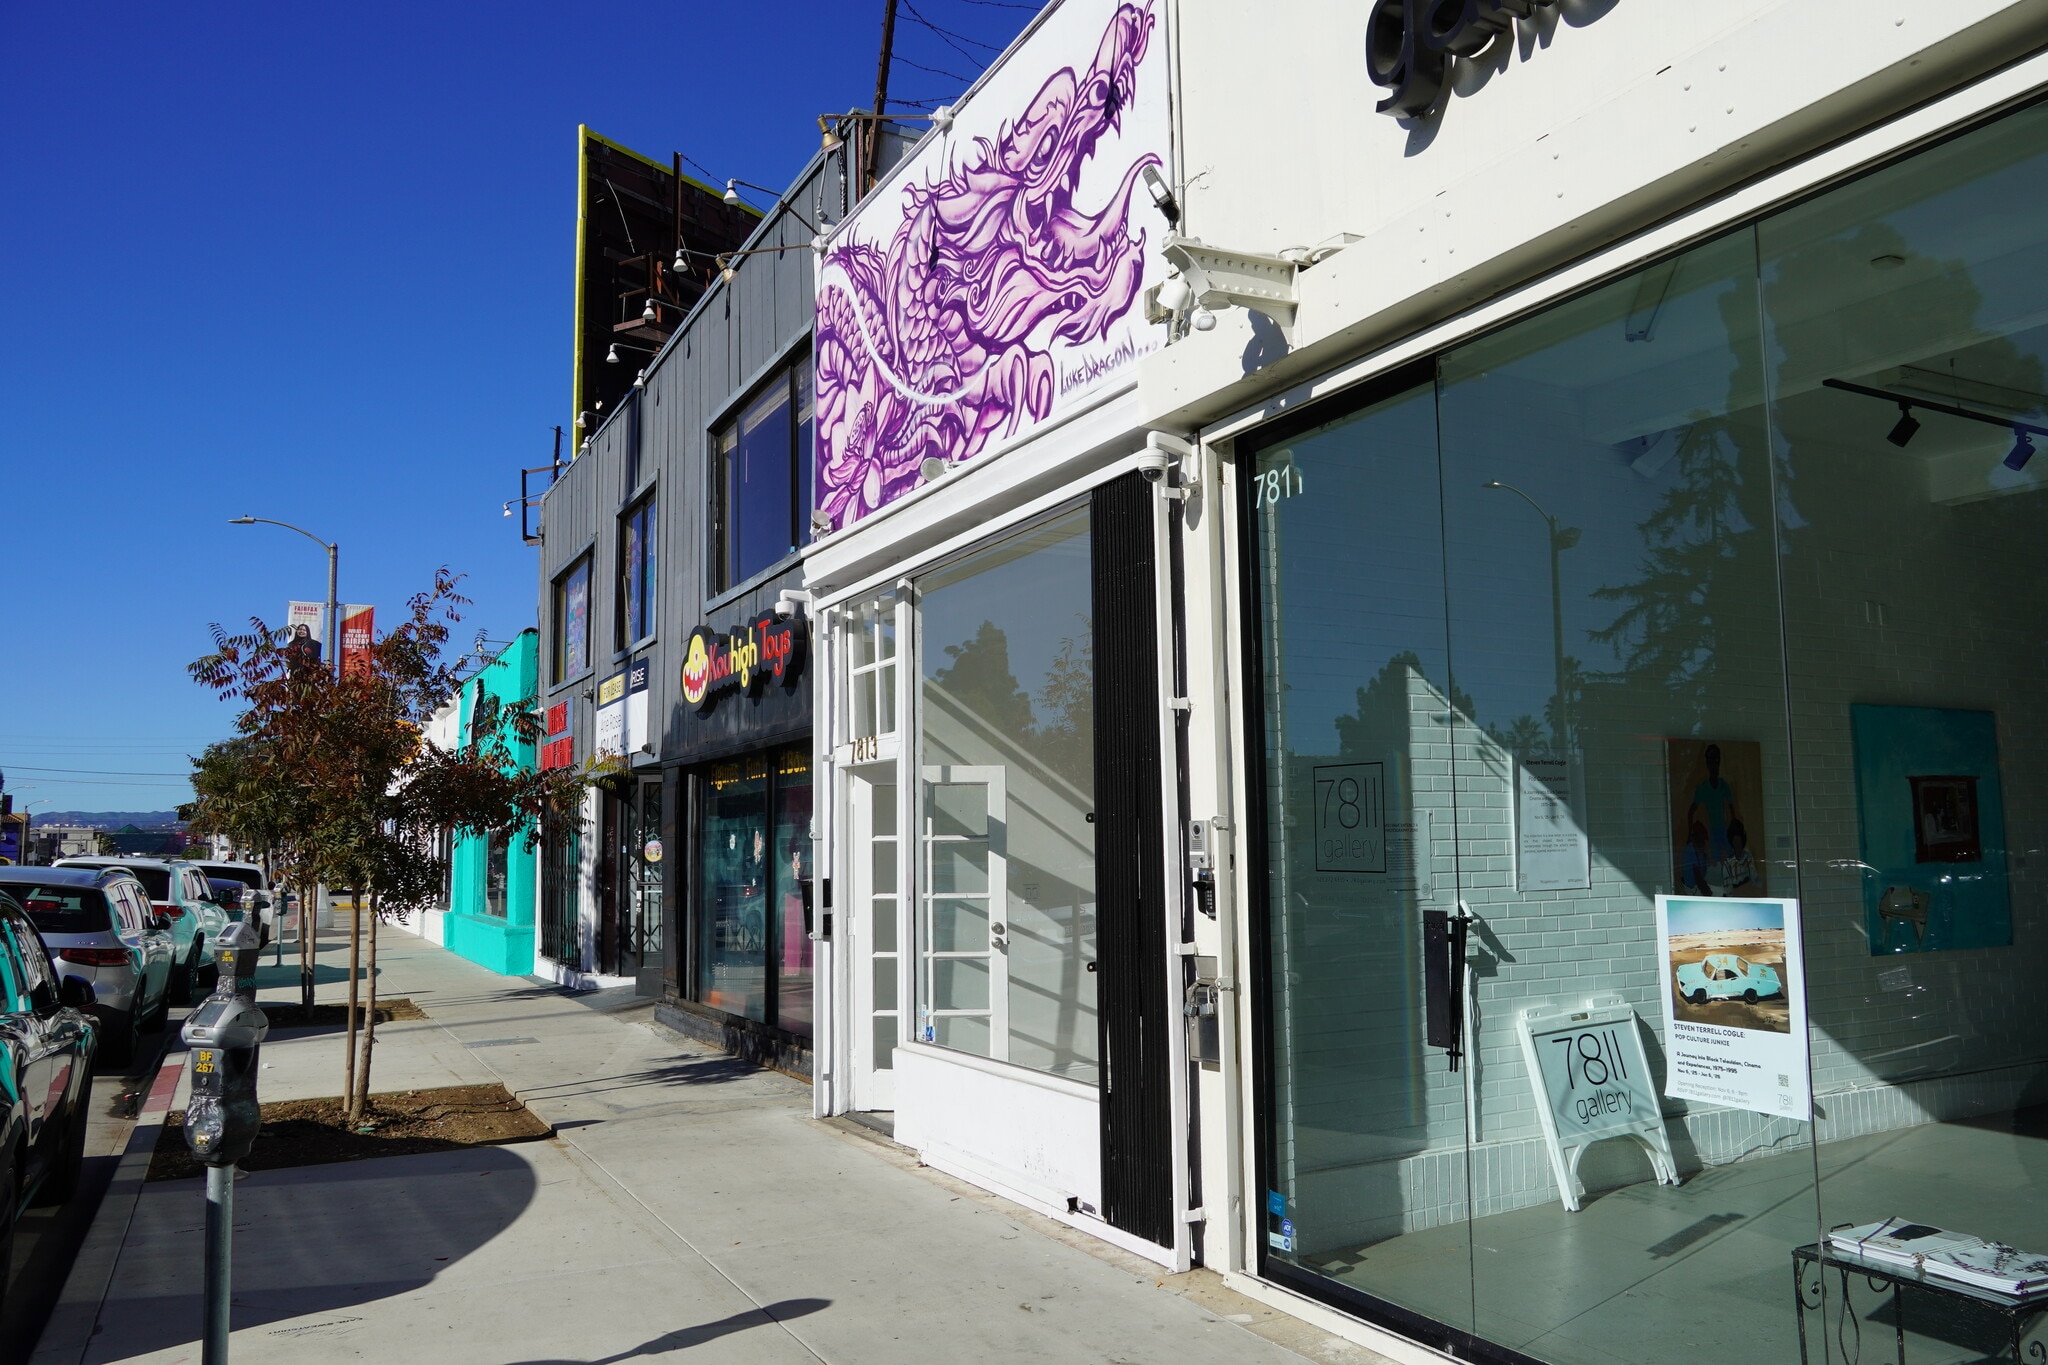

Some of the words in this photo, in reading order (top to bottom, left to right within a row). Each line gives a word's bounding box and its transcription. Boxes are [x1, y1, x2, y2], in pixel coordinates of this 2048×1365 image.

[708, 626, 758, 688] Kouhigh
[757, 619, 791, 676] Toys
[631, 667, 645, 682] RISE
[851, 736, 878, 764] 7813
[1316, 777, 1378, 829] 7811
[1323, 833, 1378, 863] gallery
[1674, 1023, 1696, 1032] STEVEN
[1696, 1026, 1722, 1036] TERRELL
[1722, 1029, 1746, 1038] COGLE:
[1686, 1035, 1710, 1044] CULTURE
[1710, 1038, 1730, 1047] JUNKIE
[196, 1063, 214, 1072] 267
[199, 1051, 213, 1061] BF
[1552, 1029, 1628, 1090] 7811
[1576, 1088, 1632, 1124] gallery
